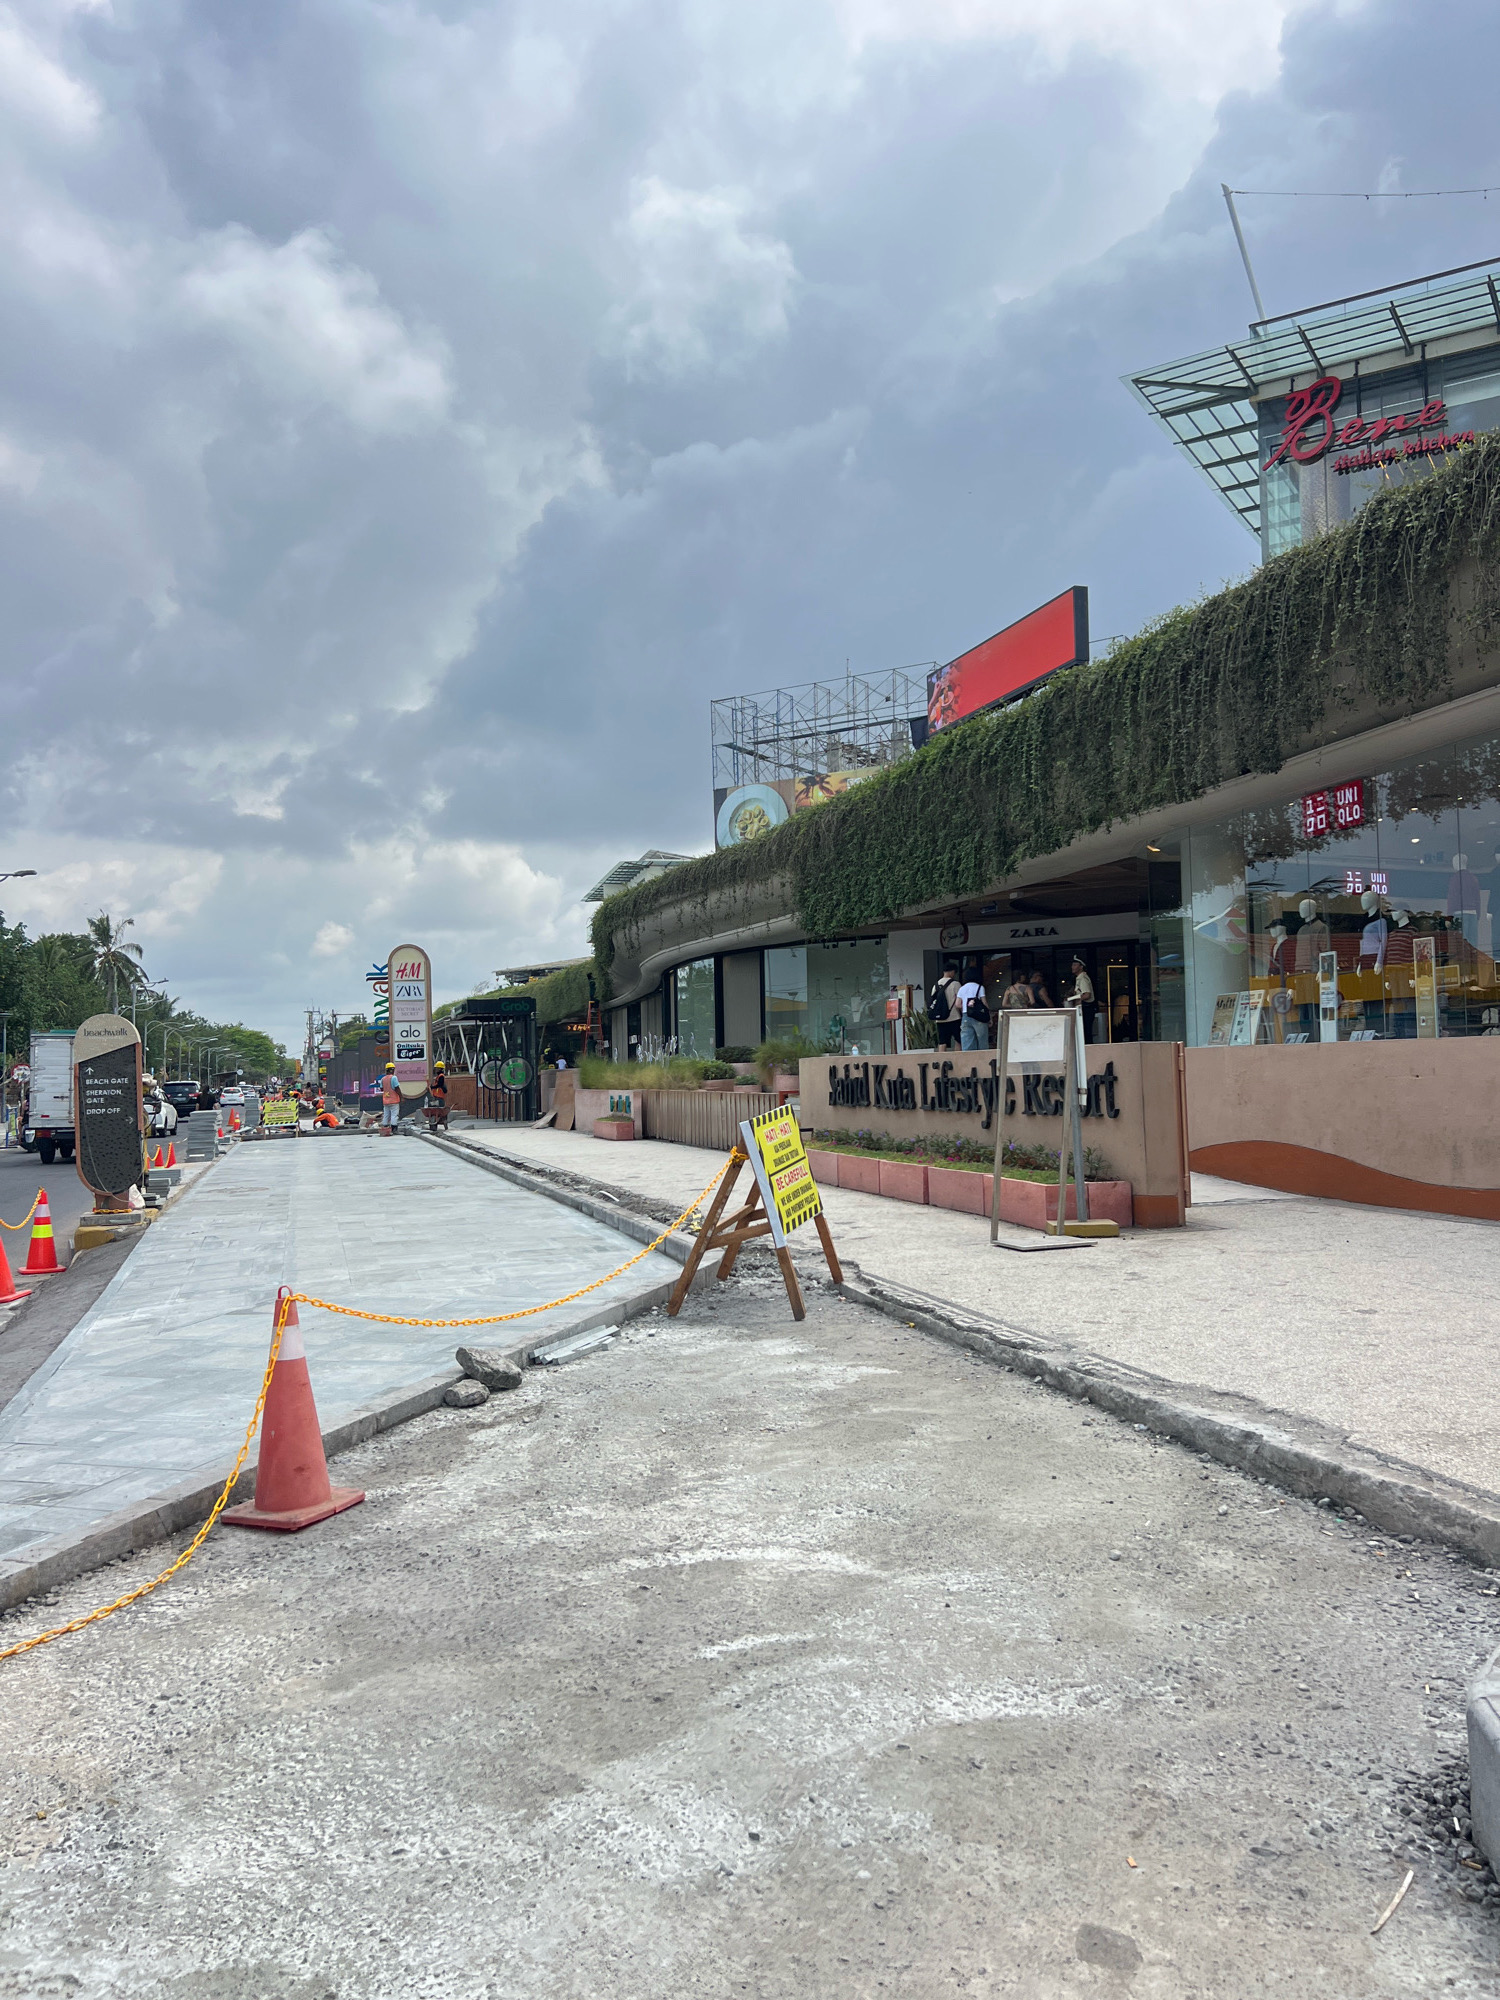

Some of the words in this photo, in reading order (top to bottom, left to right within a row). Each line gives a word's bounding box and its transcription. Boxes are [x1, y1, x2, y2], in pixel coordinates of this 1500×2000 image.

[1262, 376, 1446, 471] Bene
[1333, 447, 1397, 471] italian
[1402, 429, 1475, 455] kitchen
[1336, 786, 1358, 806] UNI
[1338, 804, 1360, 826] QLO
[1010, 926, 1060, 939] ZARA
[396, 962, 422, 980] H&M
[396, 985, 423, 998] ZARA
[501, 1000, 531, 1012] Grab
[83, 1028, 128, 1037] beachwalk
[400, 1025, 421, 1038] alo
[400, 1049, 421, 1058] Tiger
[85, 1078, 109, 1086] BEACH
[110, 1077, 129, 1085] GATE
[828, 1062, 872, 1107] Sahid
[872, 1064, 917, 1111] Kuta
[917, 1059, 1016, 1130] Lifestyle
[1021, 1061, 1120, 1119] Resrt
[764, 1127, 779, 1143] HATI
[779, 1121, 792, 1137] HATI
[776, 1176, 785, 1191] BE
